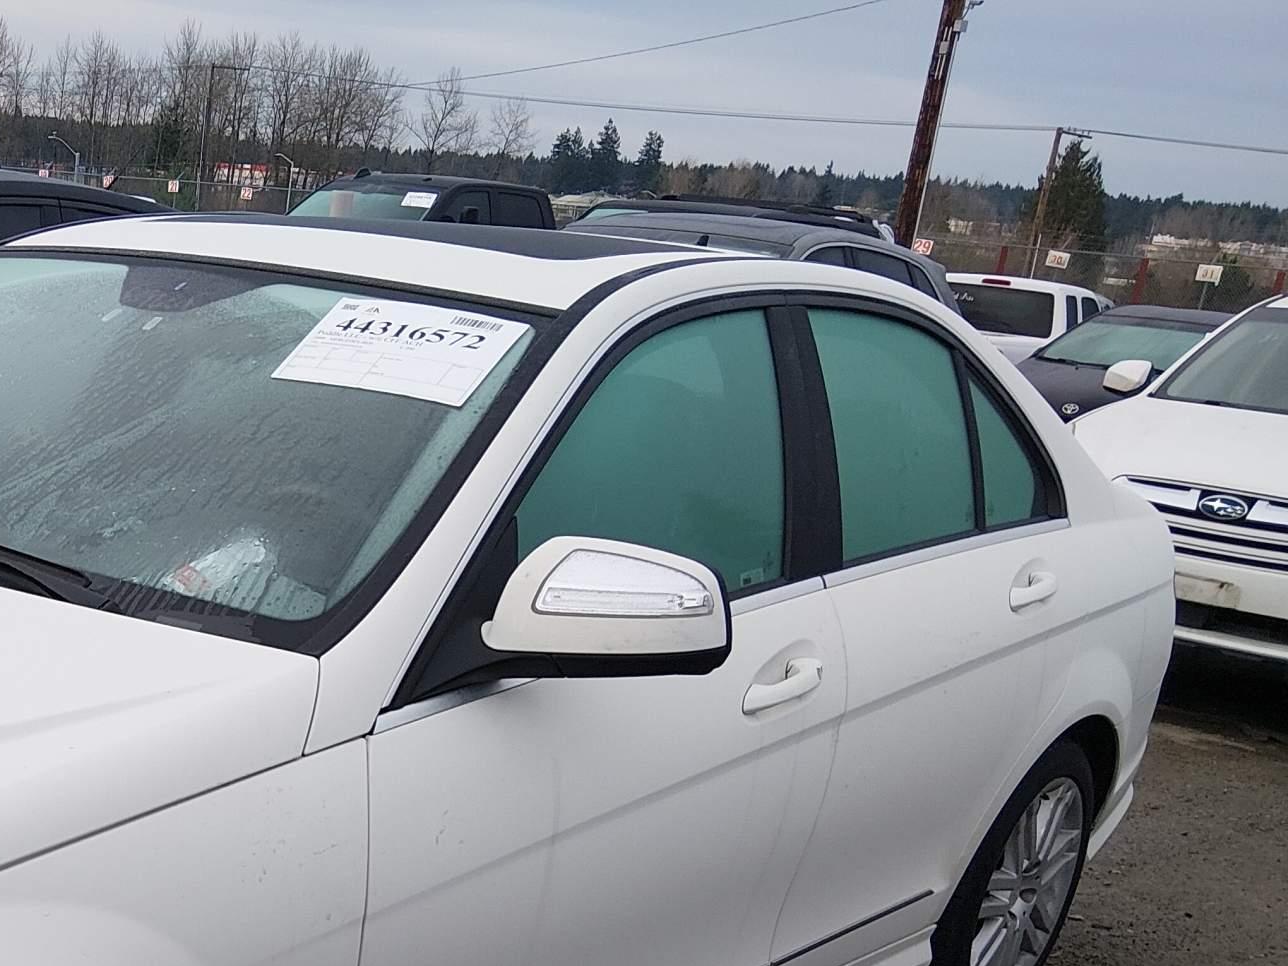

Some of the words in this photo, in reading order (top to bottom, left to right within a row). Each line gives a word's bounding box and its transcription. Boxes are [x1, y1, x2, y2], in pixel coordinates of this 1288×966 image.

[169, 182, 178, 192] 21
[241, 188, 251, 199] 22
[914, 240, 931, 254] 29
[335, 316, 487, 350] 44316572
